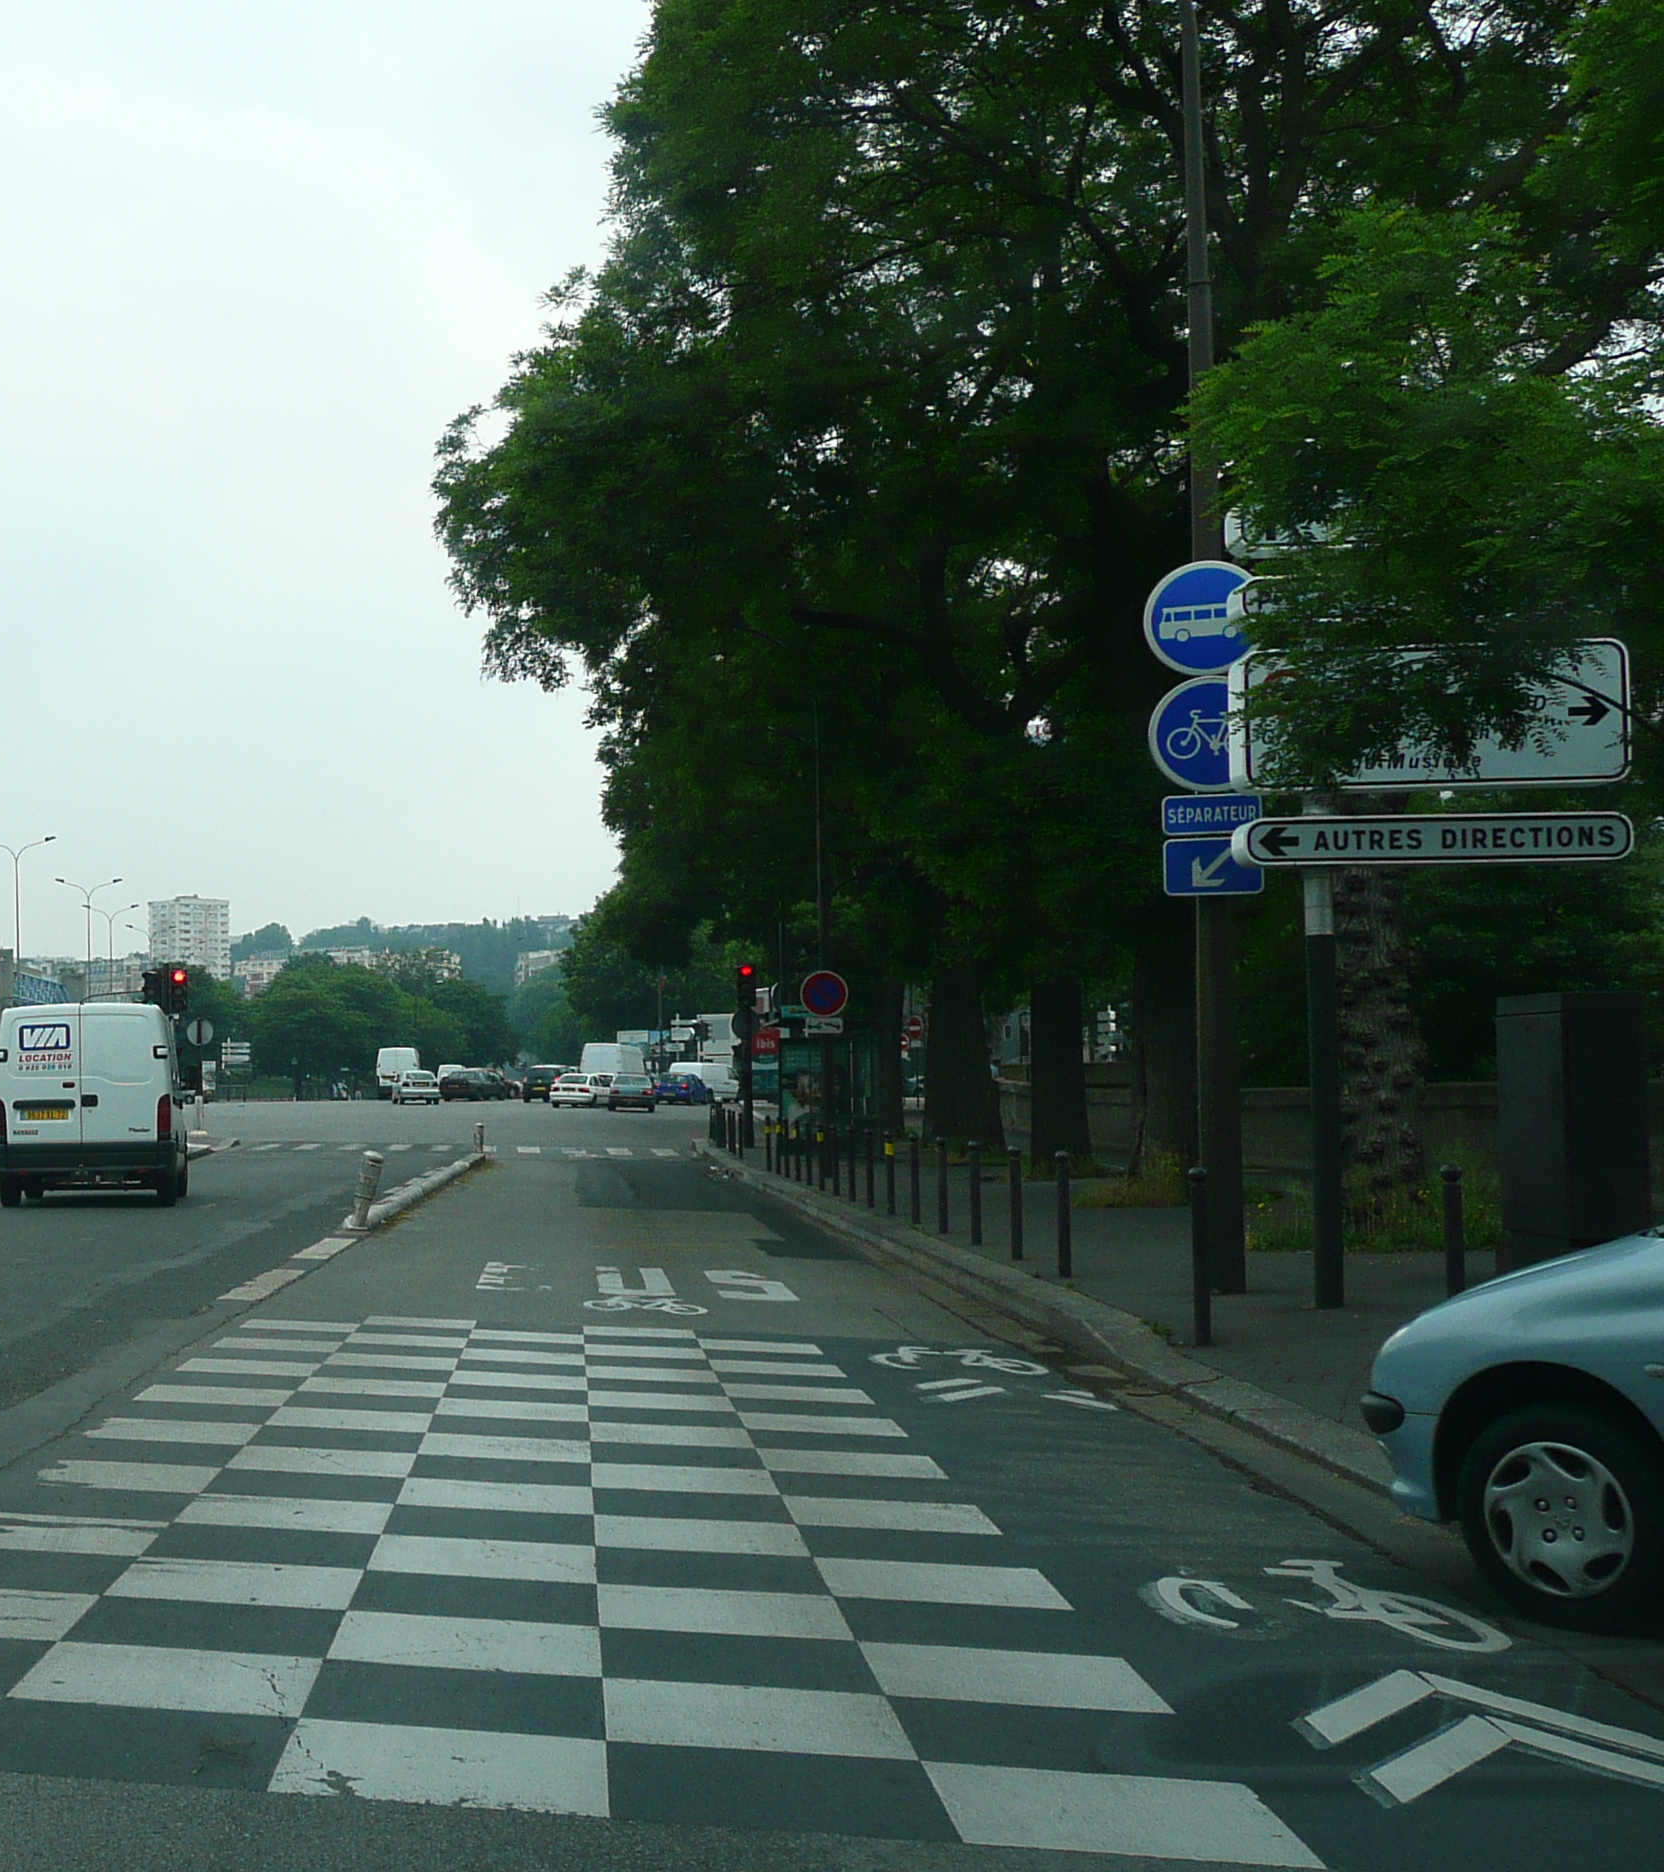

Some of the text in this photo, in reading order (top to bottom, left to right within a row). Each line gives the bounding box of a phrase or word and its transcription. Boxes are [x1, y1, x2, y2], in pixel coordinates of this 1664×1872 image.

[1167, 805, 1257, 825] SÉPARATEUR
[1313, 825, 1616, 851] AUTRES DIRECTIONS
[23, 1027, 67, 1048] VIA
[756, 1038, 776, 1050] ibis
[18, 1053, 72, 1063] LOCATION
